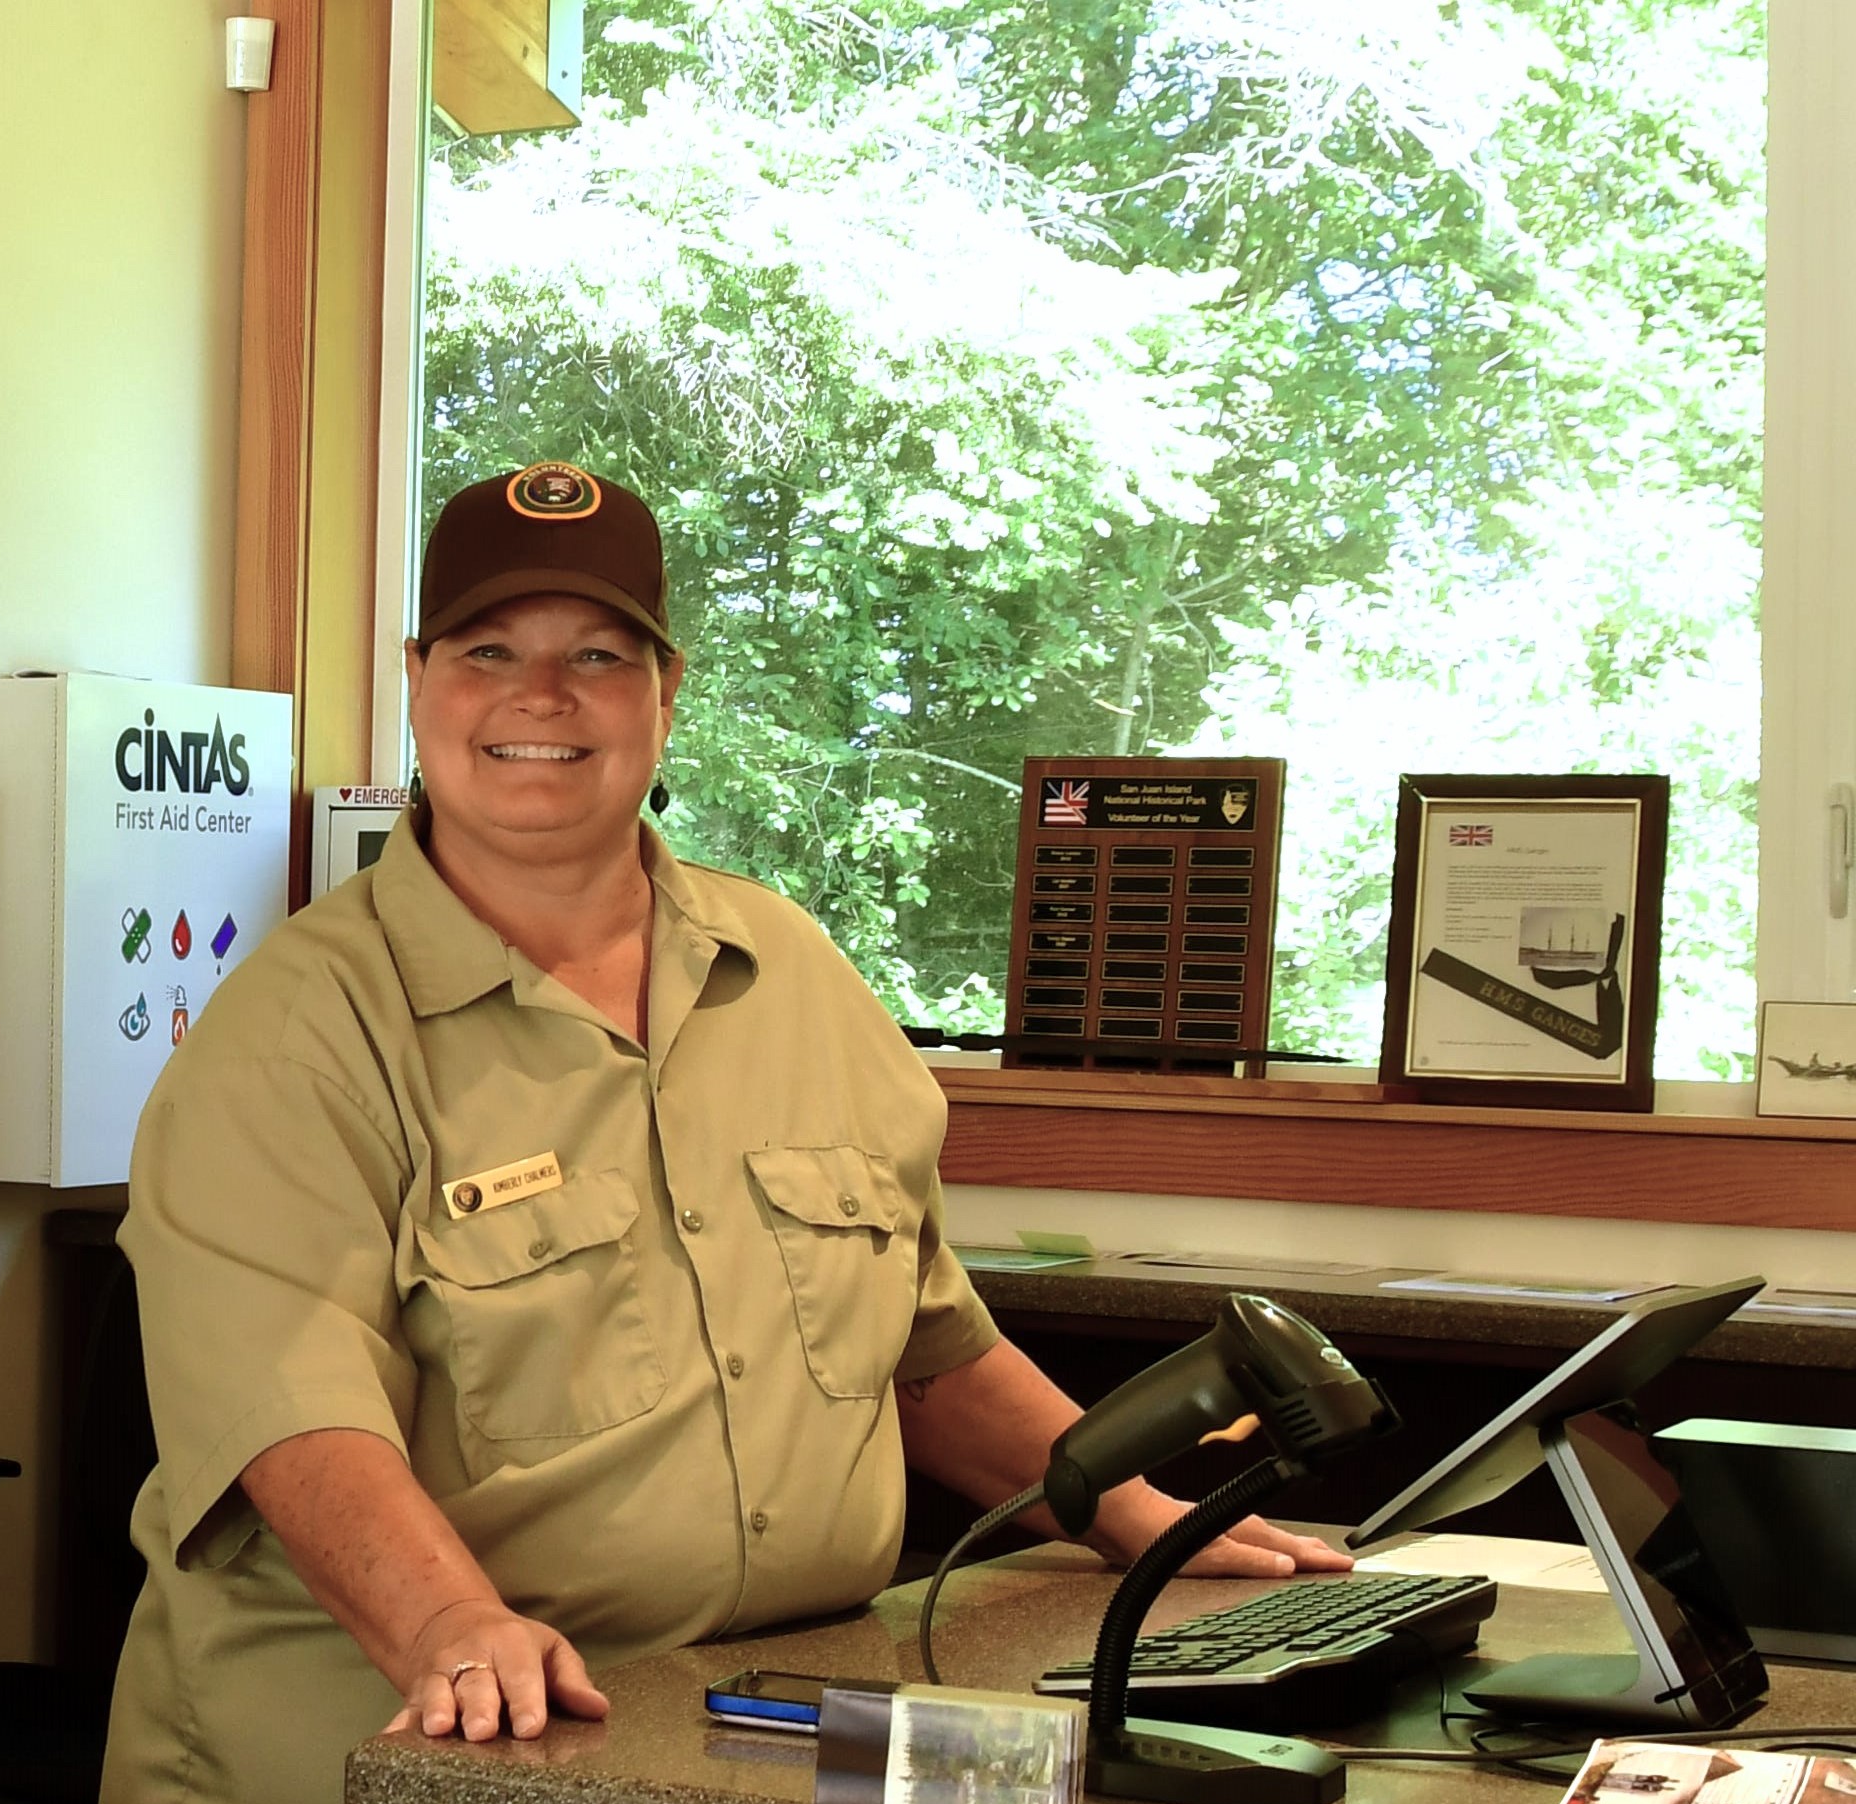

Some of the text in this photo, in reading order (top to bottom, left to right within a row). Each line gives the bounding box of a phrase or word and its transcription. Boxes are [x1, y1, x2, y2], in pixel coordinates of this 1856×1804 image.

[354, 788, 408, 805] EMERGE
[1120, 784, 1193, 795] San Juan Island
[1104, 795, 1207, 806] National Historical Park
[115, 803, 252, 834] First Aid Center
[1107, 813, 1200, 824] Volunteer of the Year
[1531, 1006, 1602, 1047] GANGES
